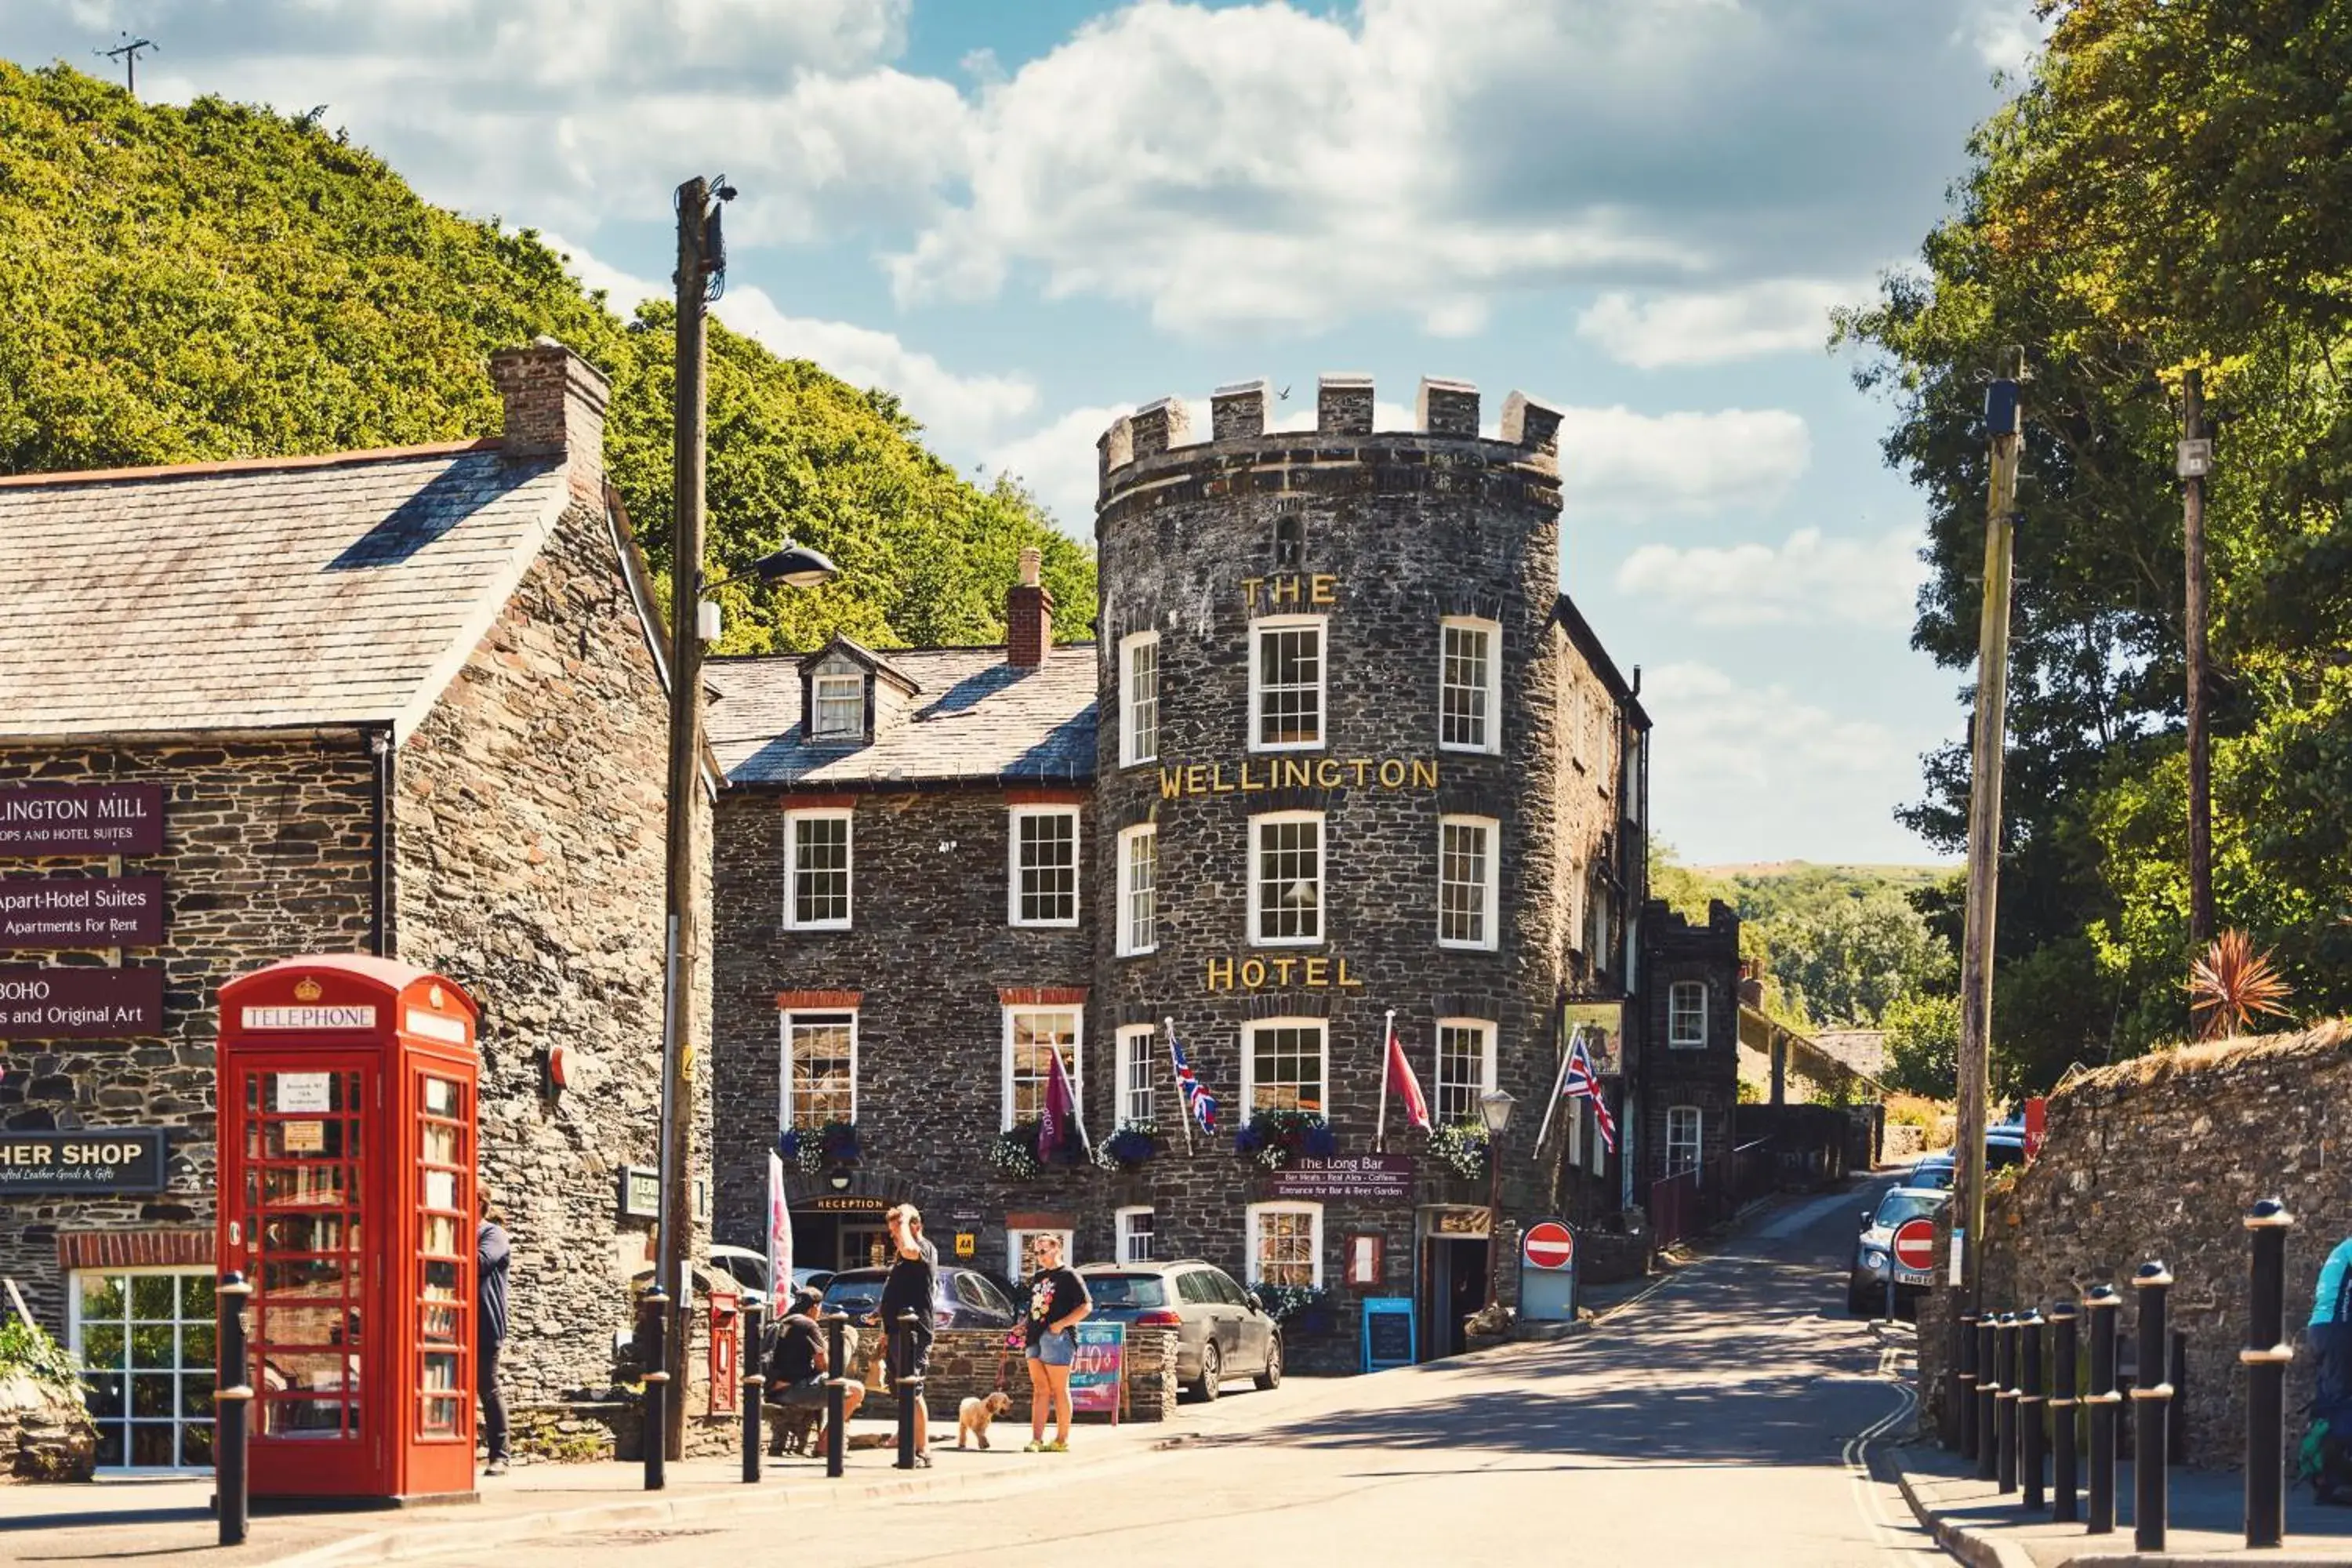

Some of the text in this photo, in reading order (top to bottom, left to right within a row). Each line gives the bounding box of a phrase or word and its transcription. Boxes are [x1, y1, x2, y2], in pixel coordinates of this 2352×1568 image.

[1240, 573, 1337, 605] THE
[1160, 758, 1439, 799] WELLINGTON
[97, 797, 147, 818] MILL
[24, 829, 49, 840] AND
[53, 829, 90, 840] HOTEL
[93, 827, 132, 838] SUITES
[95, 890, 147, 907] Suites
[5, 918, 138, 935] Apartments For Rent
[1207, 956, 1363, 991] HOTEL
[13, 1007, 42, 1023] and
[48, 1007, 109, 1026] Original
[115, 1007, 143, 1022] Art
[251, 1008, 372, 1026] TELEPHONE
[62, 1144, 142, 1164] SHOP
[1301, 1156, 1384, 1171] The Long Bar
[24, 1167, 55, 1180] Leather
[94, 1167, 114, 1181] Gifts
[1279, 1186, 1313, 1195] Entrance
[1316, 1186, 1326, 1196] for
[1374, 1186, 1403, 1196] Garden
[818, 1200, 884, 1208] RECEPTION
[959, 1240, 971, 1249] AA
